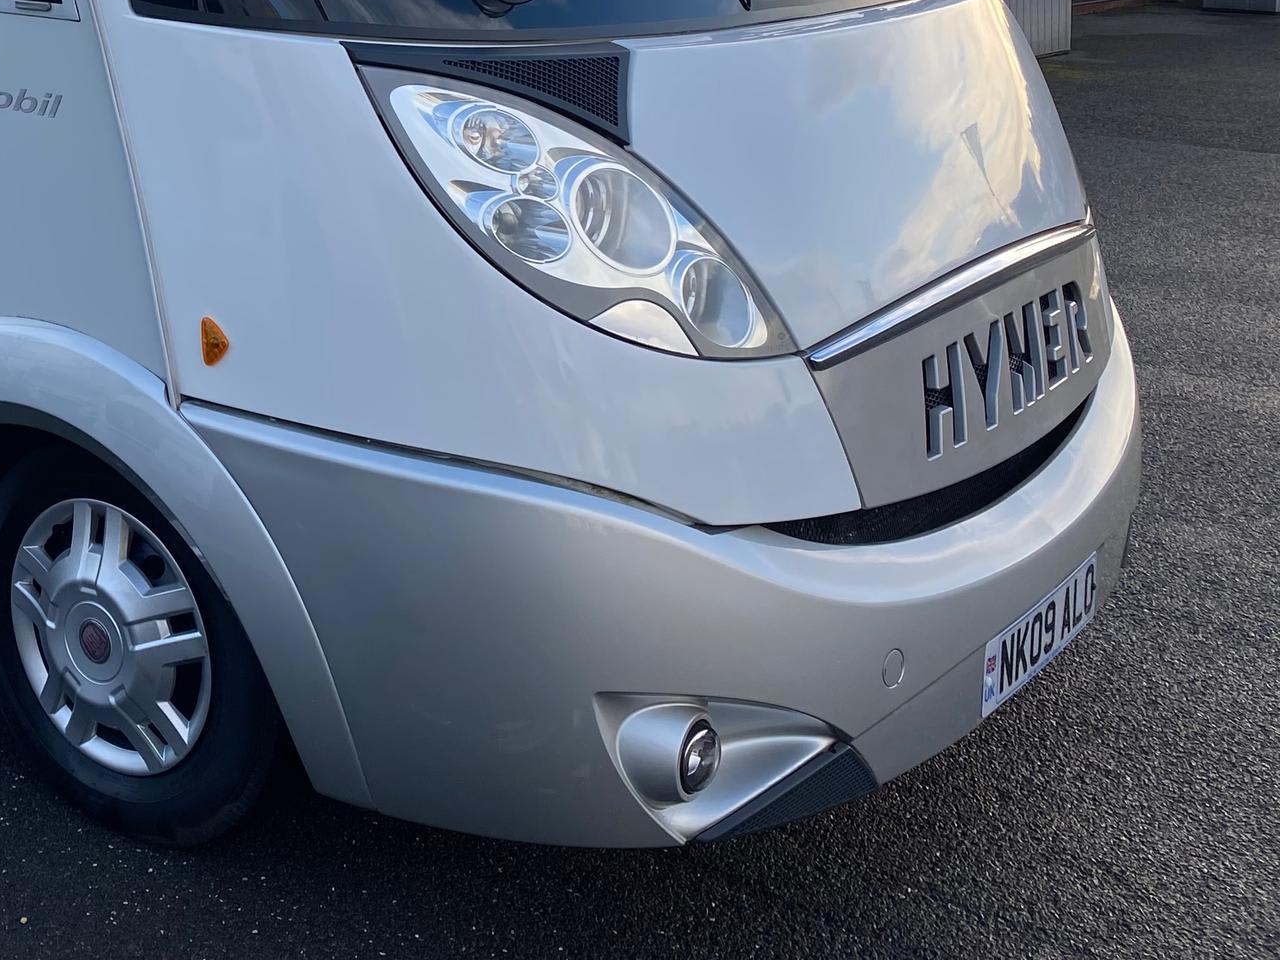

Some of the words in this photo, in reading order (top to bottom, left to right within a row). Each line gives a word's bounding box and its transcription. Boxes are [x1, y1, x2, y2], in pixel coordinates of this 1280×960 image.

[922, 280, 1093, 461] HYMER
[984, 683, 996, 703] UK
[999, 600, 1056, 695] NK09
